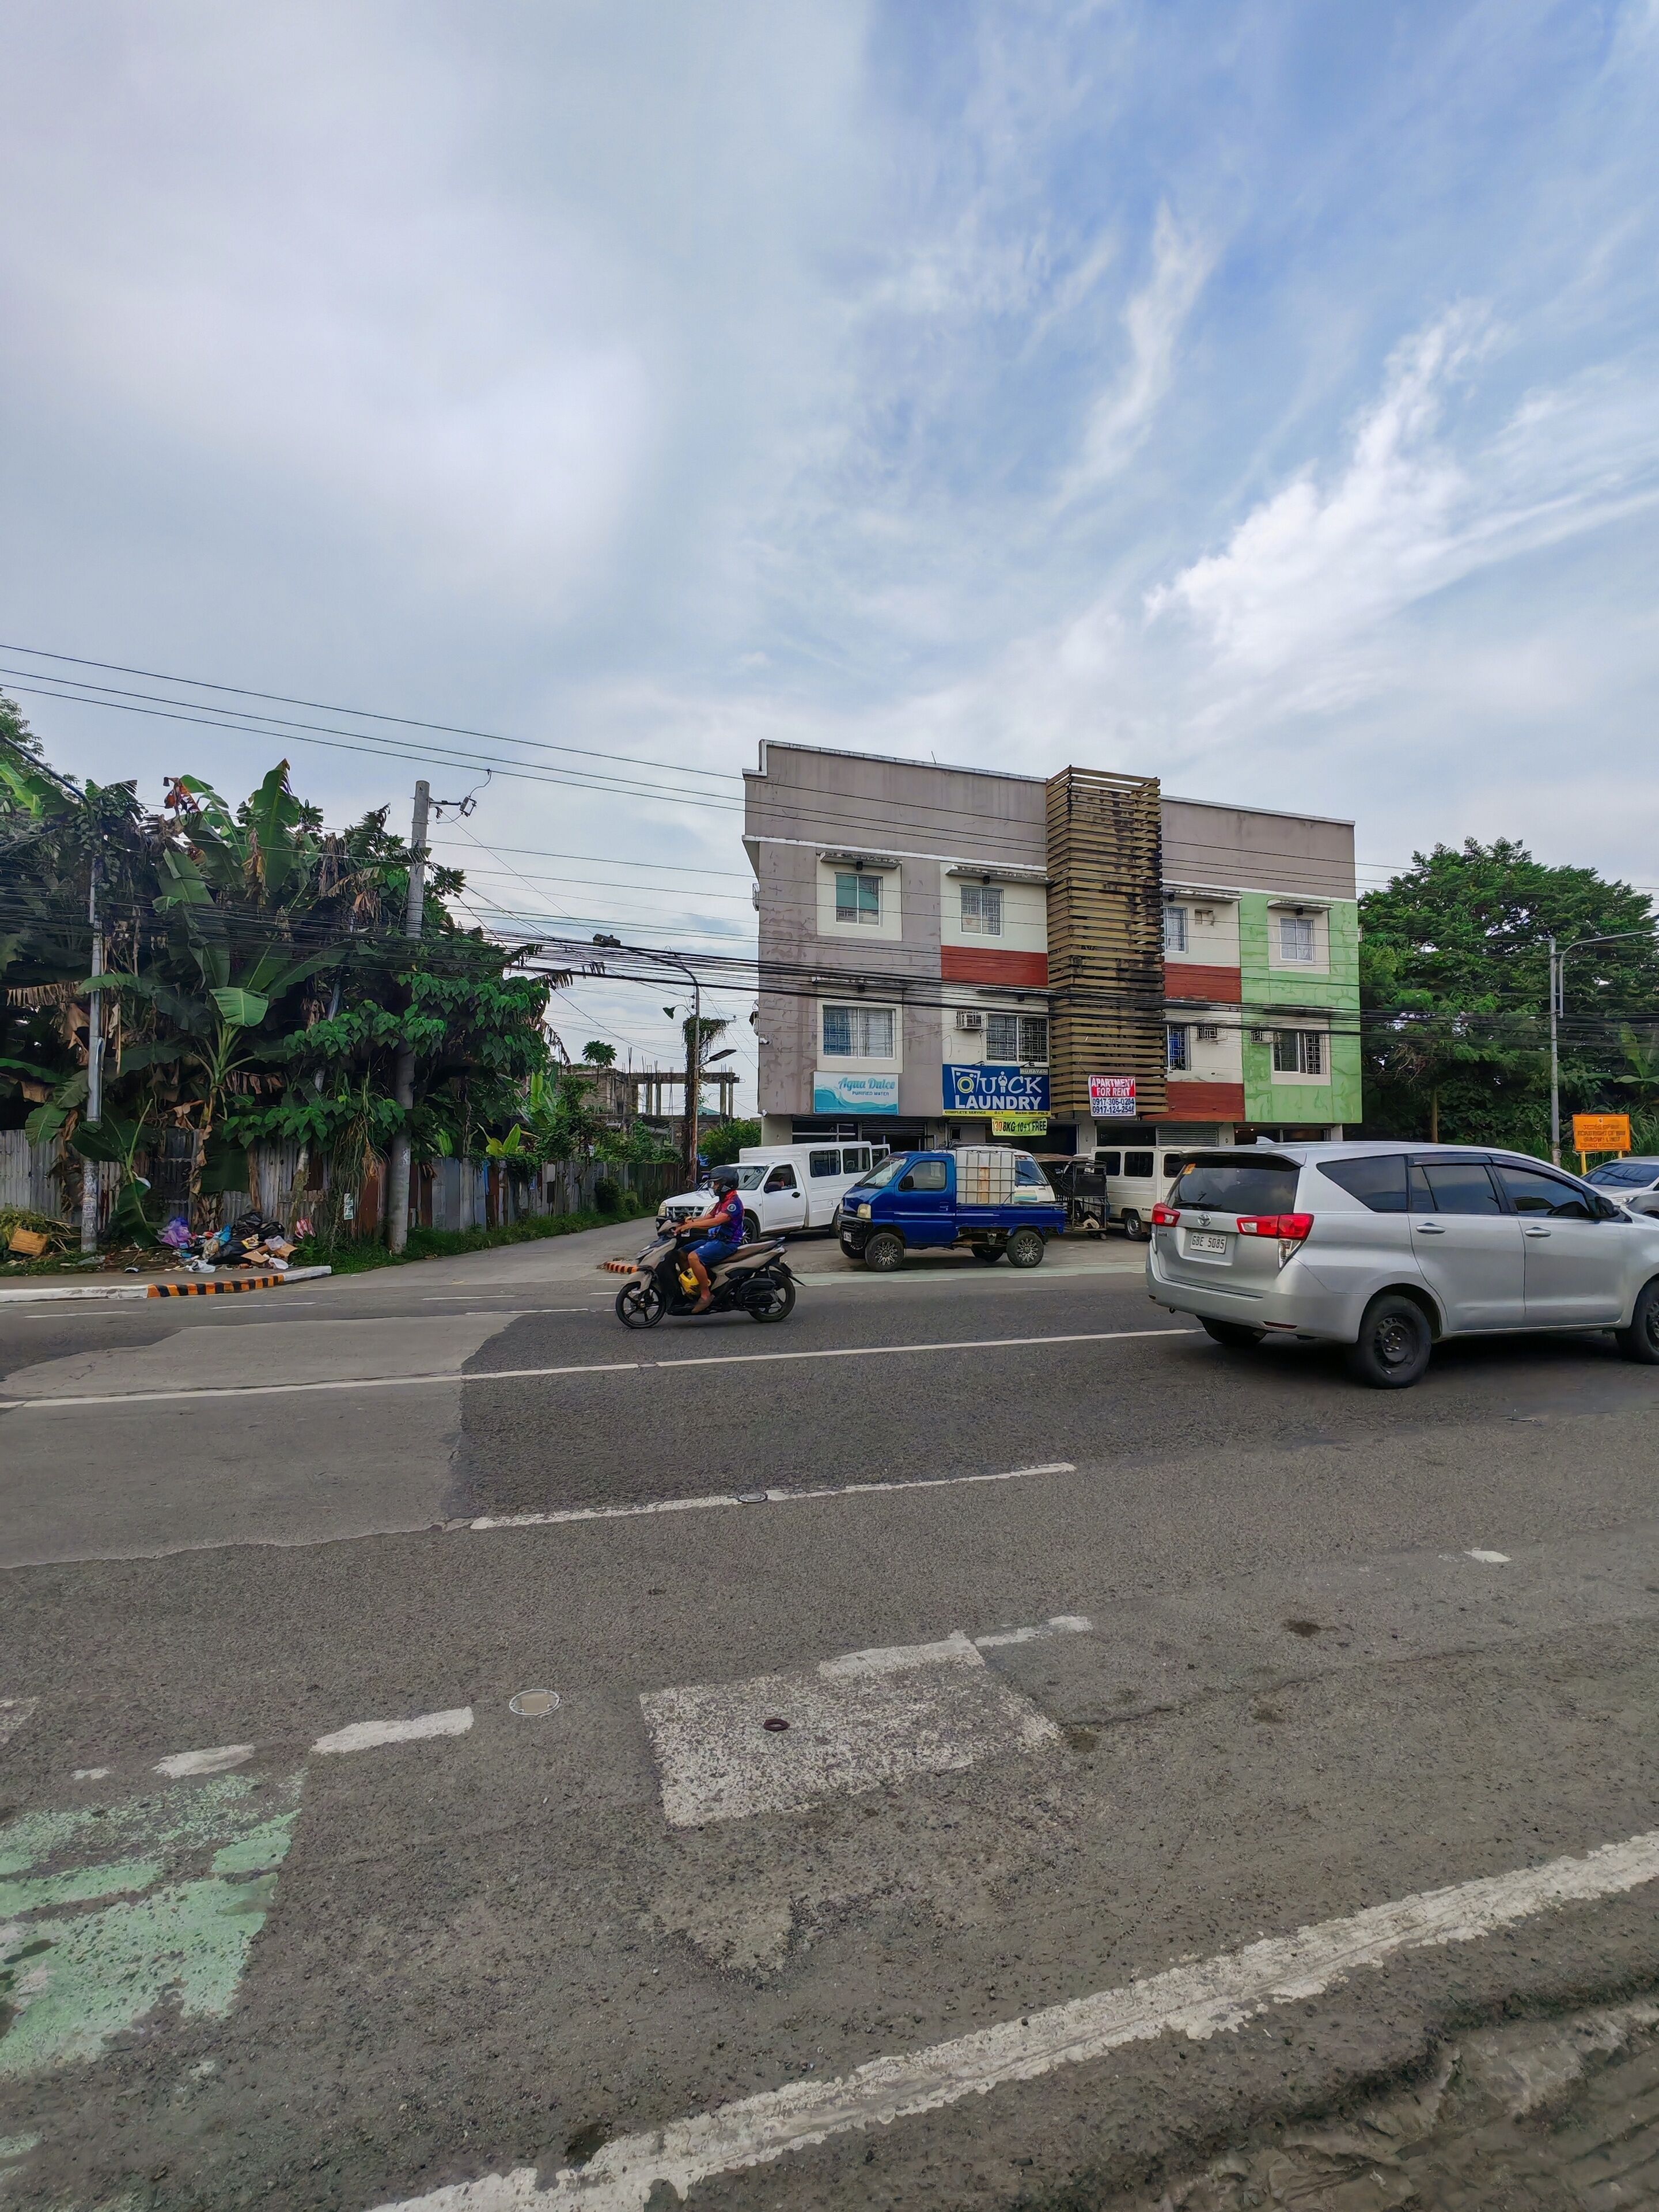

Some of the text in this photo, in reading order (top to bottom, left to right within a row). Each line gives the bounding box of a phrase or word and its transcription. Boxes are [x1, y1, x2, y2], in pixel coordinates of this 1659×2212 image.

[838, 1077, 866, 1091] Agua
[1092, 1078, 1134, 1088] APARTMENT
[1096, 1087, 1131, 1096] FOR RENT
[955, 1094, 1042, 1110] LAUNDRY
[1031, 1120, 1047, 1131] FREE
